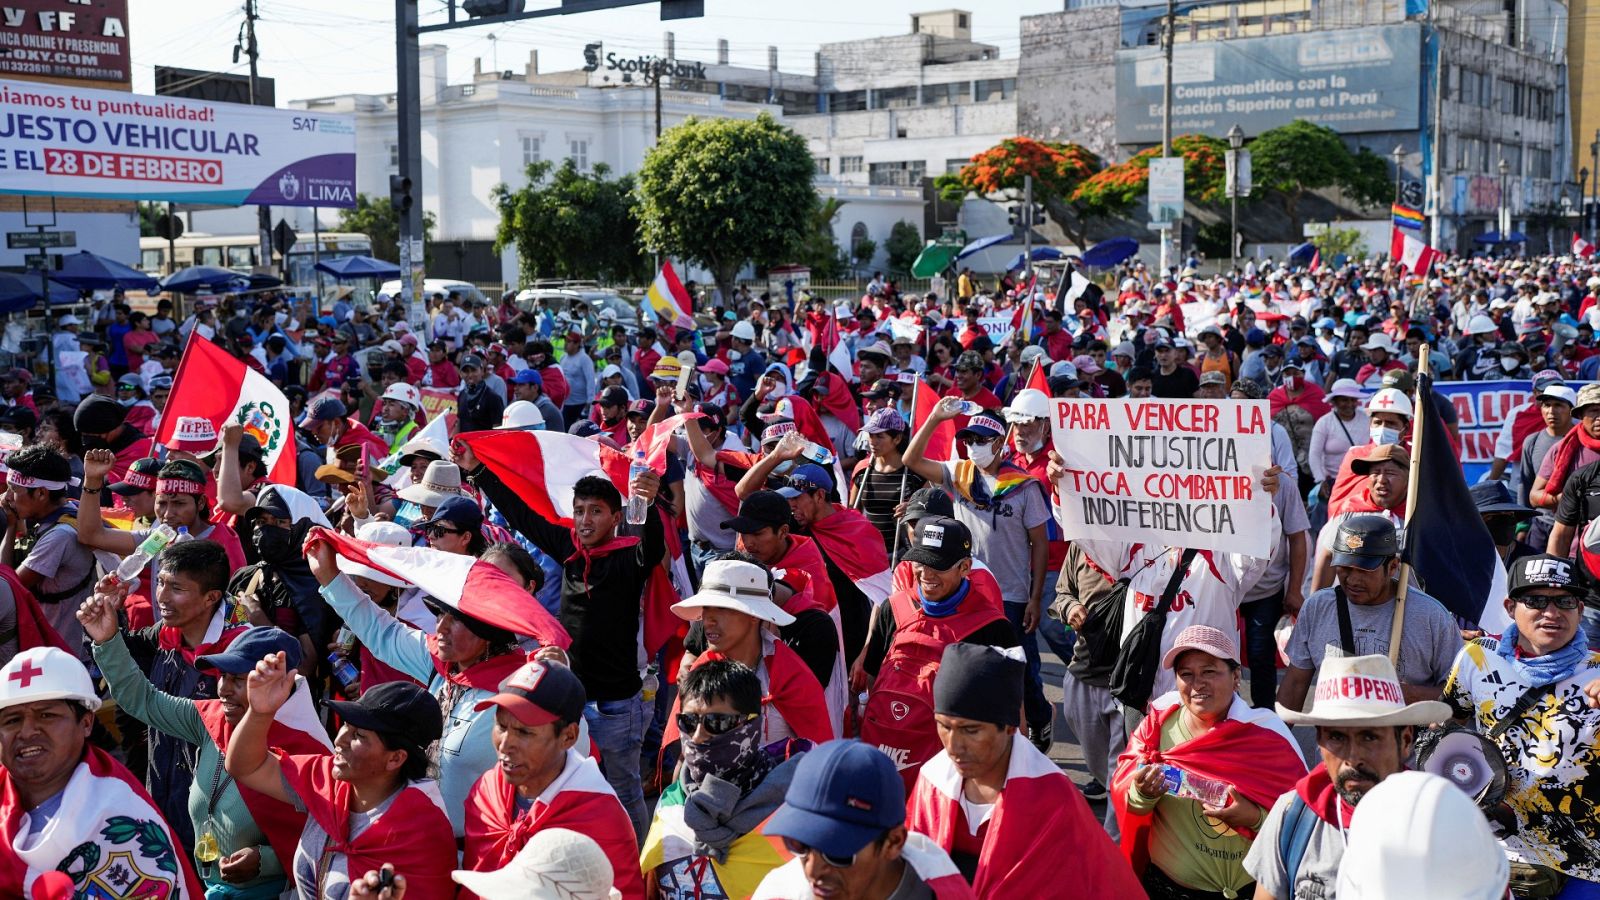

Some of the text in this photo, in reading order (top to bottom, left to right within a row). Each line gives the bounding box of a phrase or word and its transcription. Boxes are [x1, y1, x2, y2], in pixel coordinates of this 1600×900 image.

[22, 34, 56, 49] ONLINE
[56, 37, 64, 50] Y
[65, 38, 121, 56] PRESENCIAL
[1174, 79, 1294, 100] Comprometidos
[1330, 74, 1347, 89] la
[0, 86, 215, 122] iamos tu puntualidad!
[1226, 96, 1292, 114] Superior
[1295, 96, 1316, 109] en
[1319, 93, 1335, 107] el
[1339, 89, 1378, 106] Perú
[292, 117, 319, 132] SAT
[103, 121, 261, 157] VEHICULAR
[14, 149, 44, 171] EL
[48, 151, 79, 175] 28
[82, 153, 116, 177] DE
[119, 155, 221, 183] FEBRERO
[308, 185, 353, 202] LIMA
[1057, 402, 1266, 434] PARA VENCER LA
[1108, 435, 1239, 472] INJUSTICIA
[1065, 468, 1252, 500] TOCA COMBATIR
[1082, 496, 1236, 534] INDIFERENCIA
[1525, 559, 1571, 578] UFC
[1134, 591, 1185, 612] PEU
[1363, 678, 1398, 704] PERU
